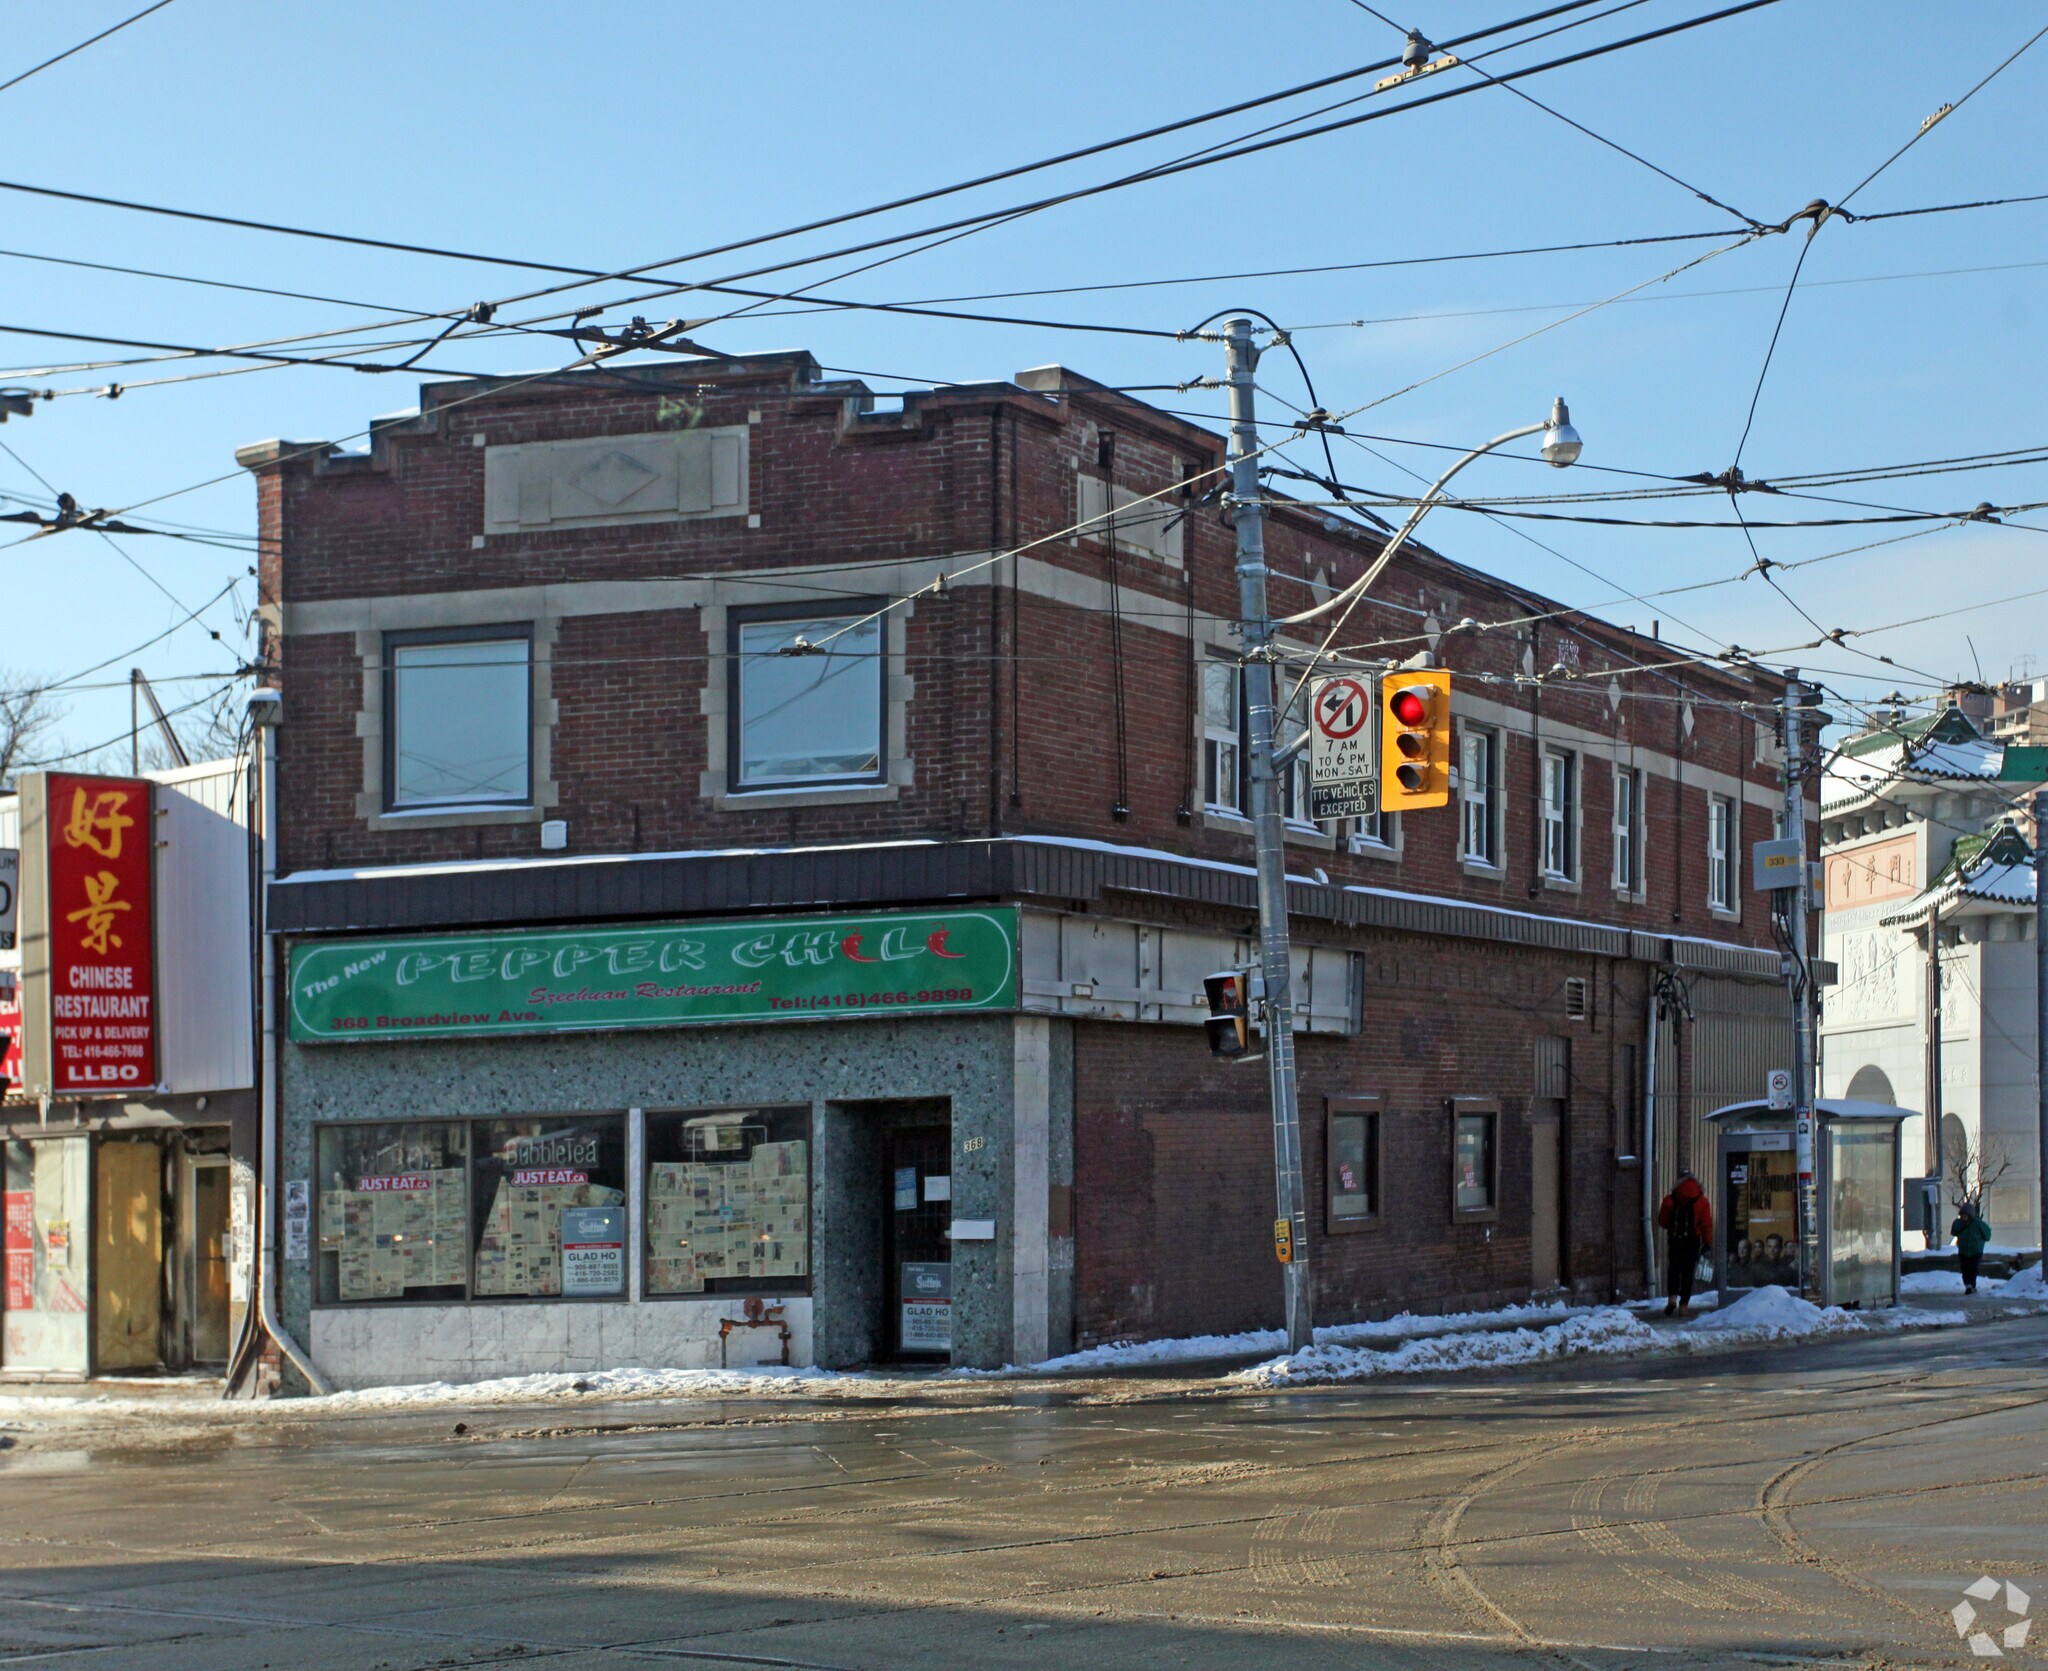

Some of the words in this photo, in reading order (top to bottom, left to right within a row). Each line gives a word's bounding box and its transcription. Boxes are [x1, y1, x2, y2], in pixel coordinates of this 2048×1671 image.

[1326, 740, 1334, 752] 7
[1341, 740, 1358, 752] AM
[1319, 757, 1332, 767] TO
[1337, 753, 1345, 765] 6
[1350, 754, 1366, 764] PM
[1312, 789, 1329, 802] TTC
[1331, 784, 1374, 800] VEHICLES
[1321, 801, 1367, 816] EXCEPTED
[396, 938, 707, 986] PEPPER
[69, 965, 133, 989] CHINESE
[302, 975, 340, 998] The
[344, 950, 387, 979] New
[527, 986, 628, 1009] Szechuan
[634, 980, 763, 999] Restaurant
[54, 994, 150, 1018] RESTAURANT
[331, 1016, 370, 1031] 368
[376, 1010, 490, 1028] Broadview
[498, 1009, 544, 1024] Ave.
[55, 1026, 77, 1039] PICK
[79, 1026, 93, 1039] UP
[95, 1026, 102, 1039] &
[104, 1026, 150, 1039] DELIVERY
[62, 1045, 82, 1058] TEL:
[68, 1064, 139, 1081] LLBO
[965, 1138, 982, 1152] 368
[358, 1178, 391, 1191] JUST
[513, 1171, 547, 1184] JUST
[568, 1253, 598, 1261] GLAD
[601, 1252, 617, 1260] HO
[907, 1307, 933, 1316] GLAD
[935, 1308, 949, 1317] HO
